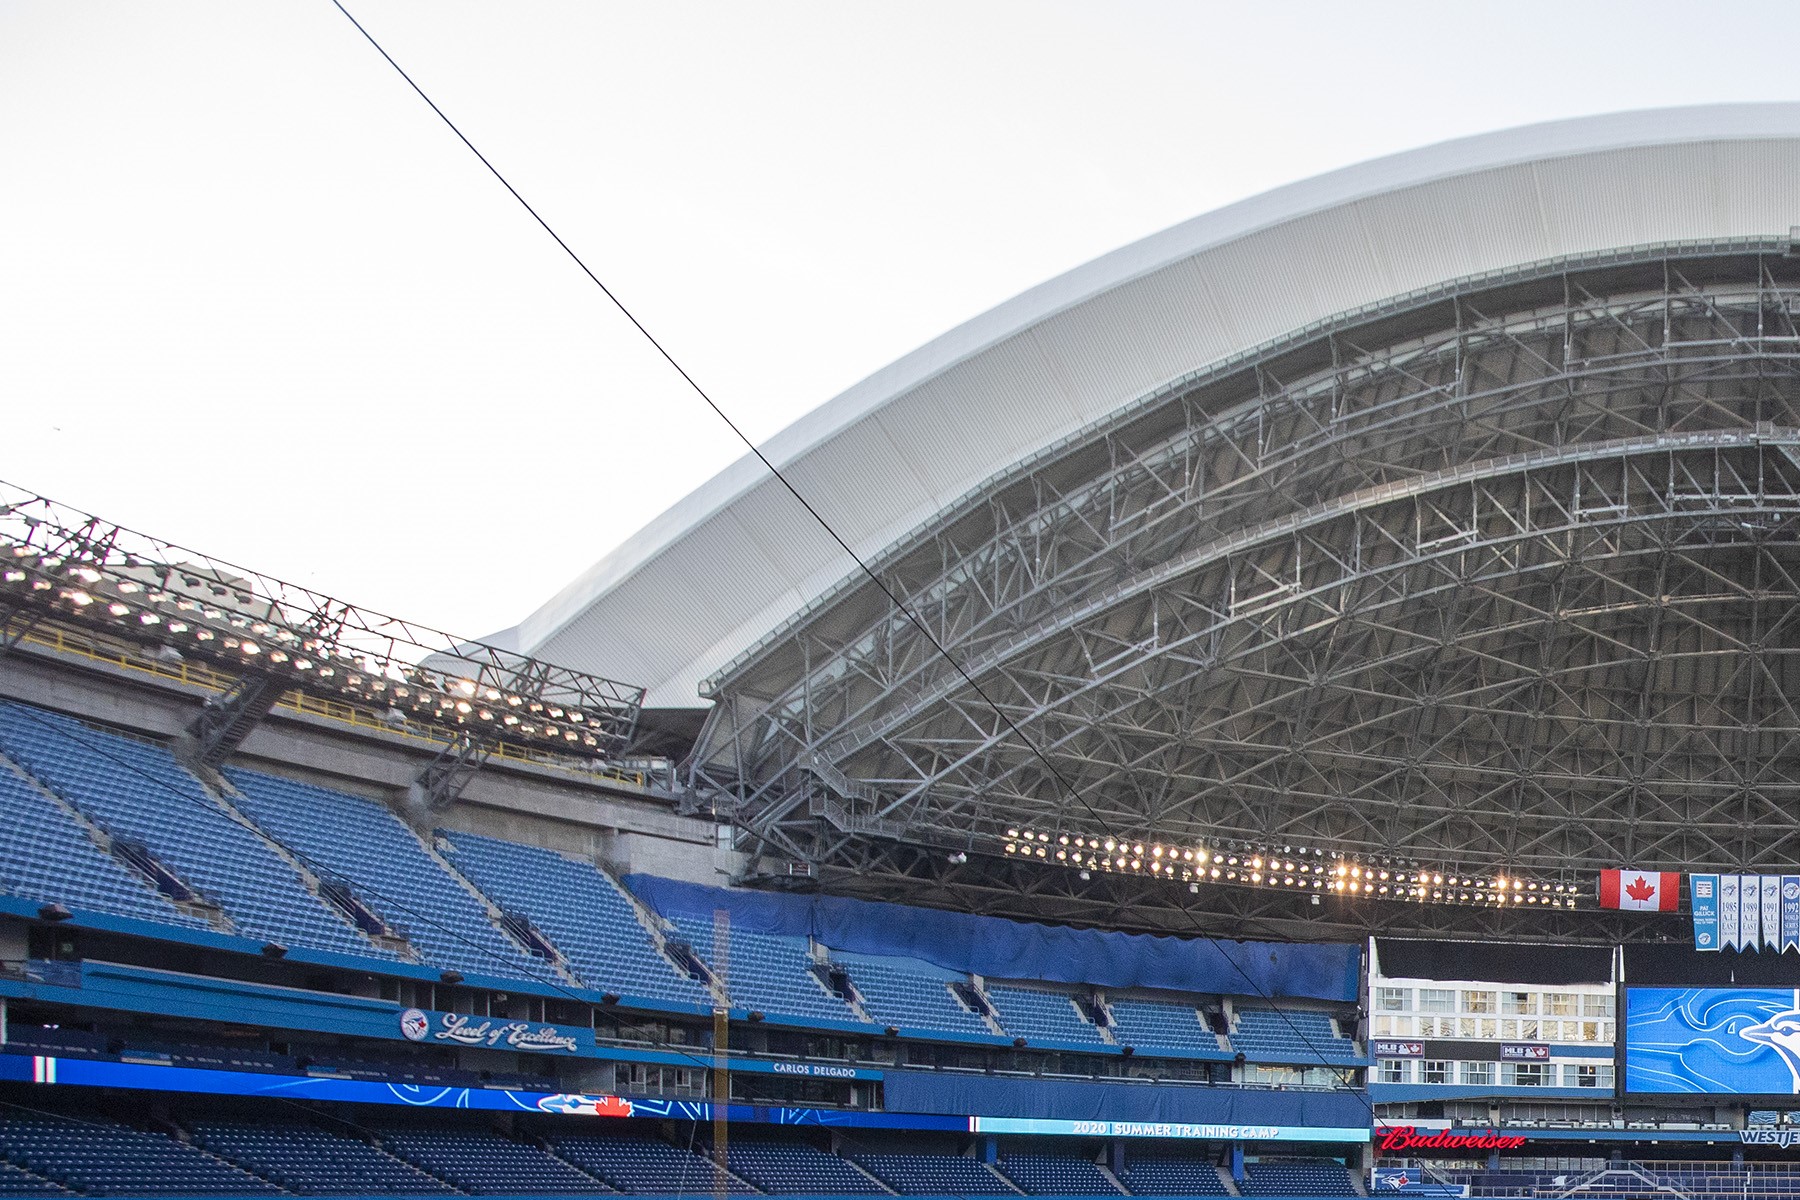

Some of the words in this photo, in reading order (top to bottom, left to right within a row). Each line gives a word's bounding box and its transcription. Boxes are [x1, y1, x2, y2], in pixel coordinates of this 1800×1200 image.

[1722, 902, 1737, 912] 1985
[1743, 902, 1758, 912] 1989
[1763, 902, 1777, 912] 1991
[1784, 902, 1799, 913] 1992
[1722, 923, 1737, 931] EAST
[1743, 923, 1757, 931] EAST
[435, 1013, 491, 1043] Level
[487, 1026, 508, 1045] of
[507, 1023, 577, 1052] Excellence
[774, 1063, 809, 1074] CARLOS
[813, 1066, 856, 1078] DELGADO
[1073, 1121, 1107, 1135] 2020
[1114, 1123, 1171, 1137] SUMMER
[1175, 1125, 1239, 1138] TRAINING
[1240, 1127, 1280, 1139] CAMP
[1375, 1125, 1527, 1150] Budweiser
